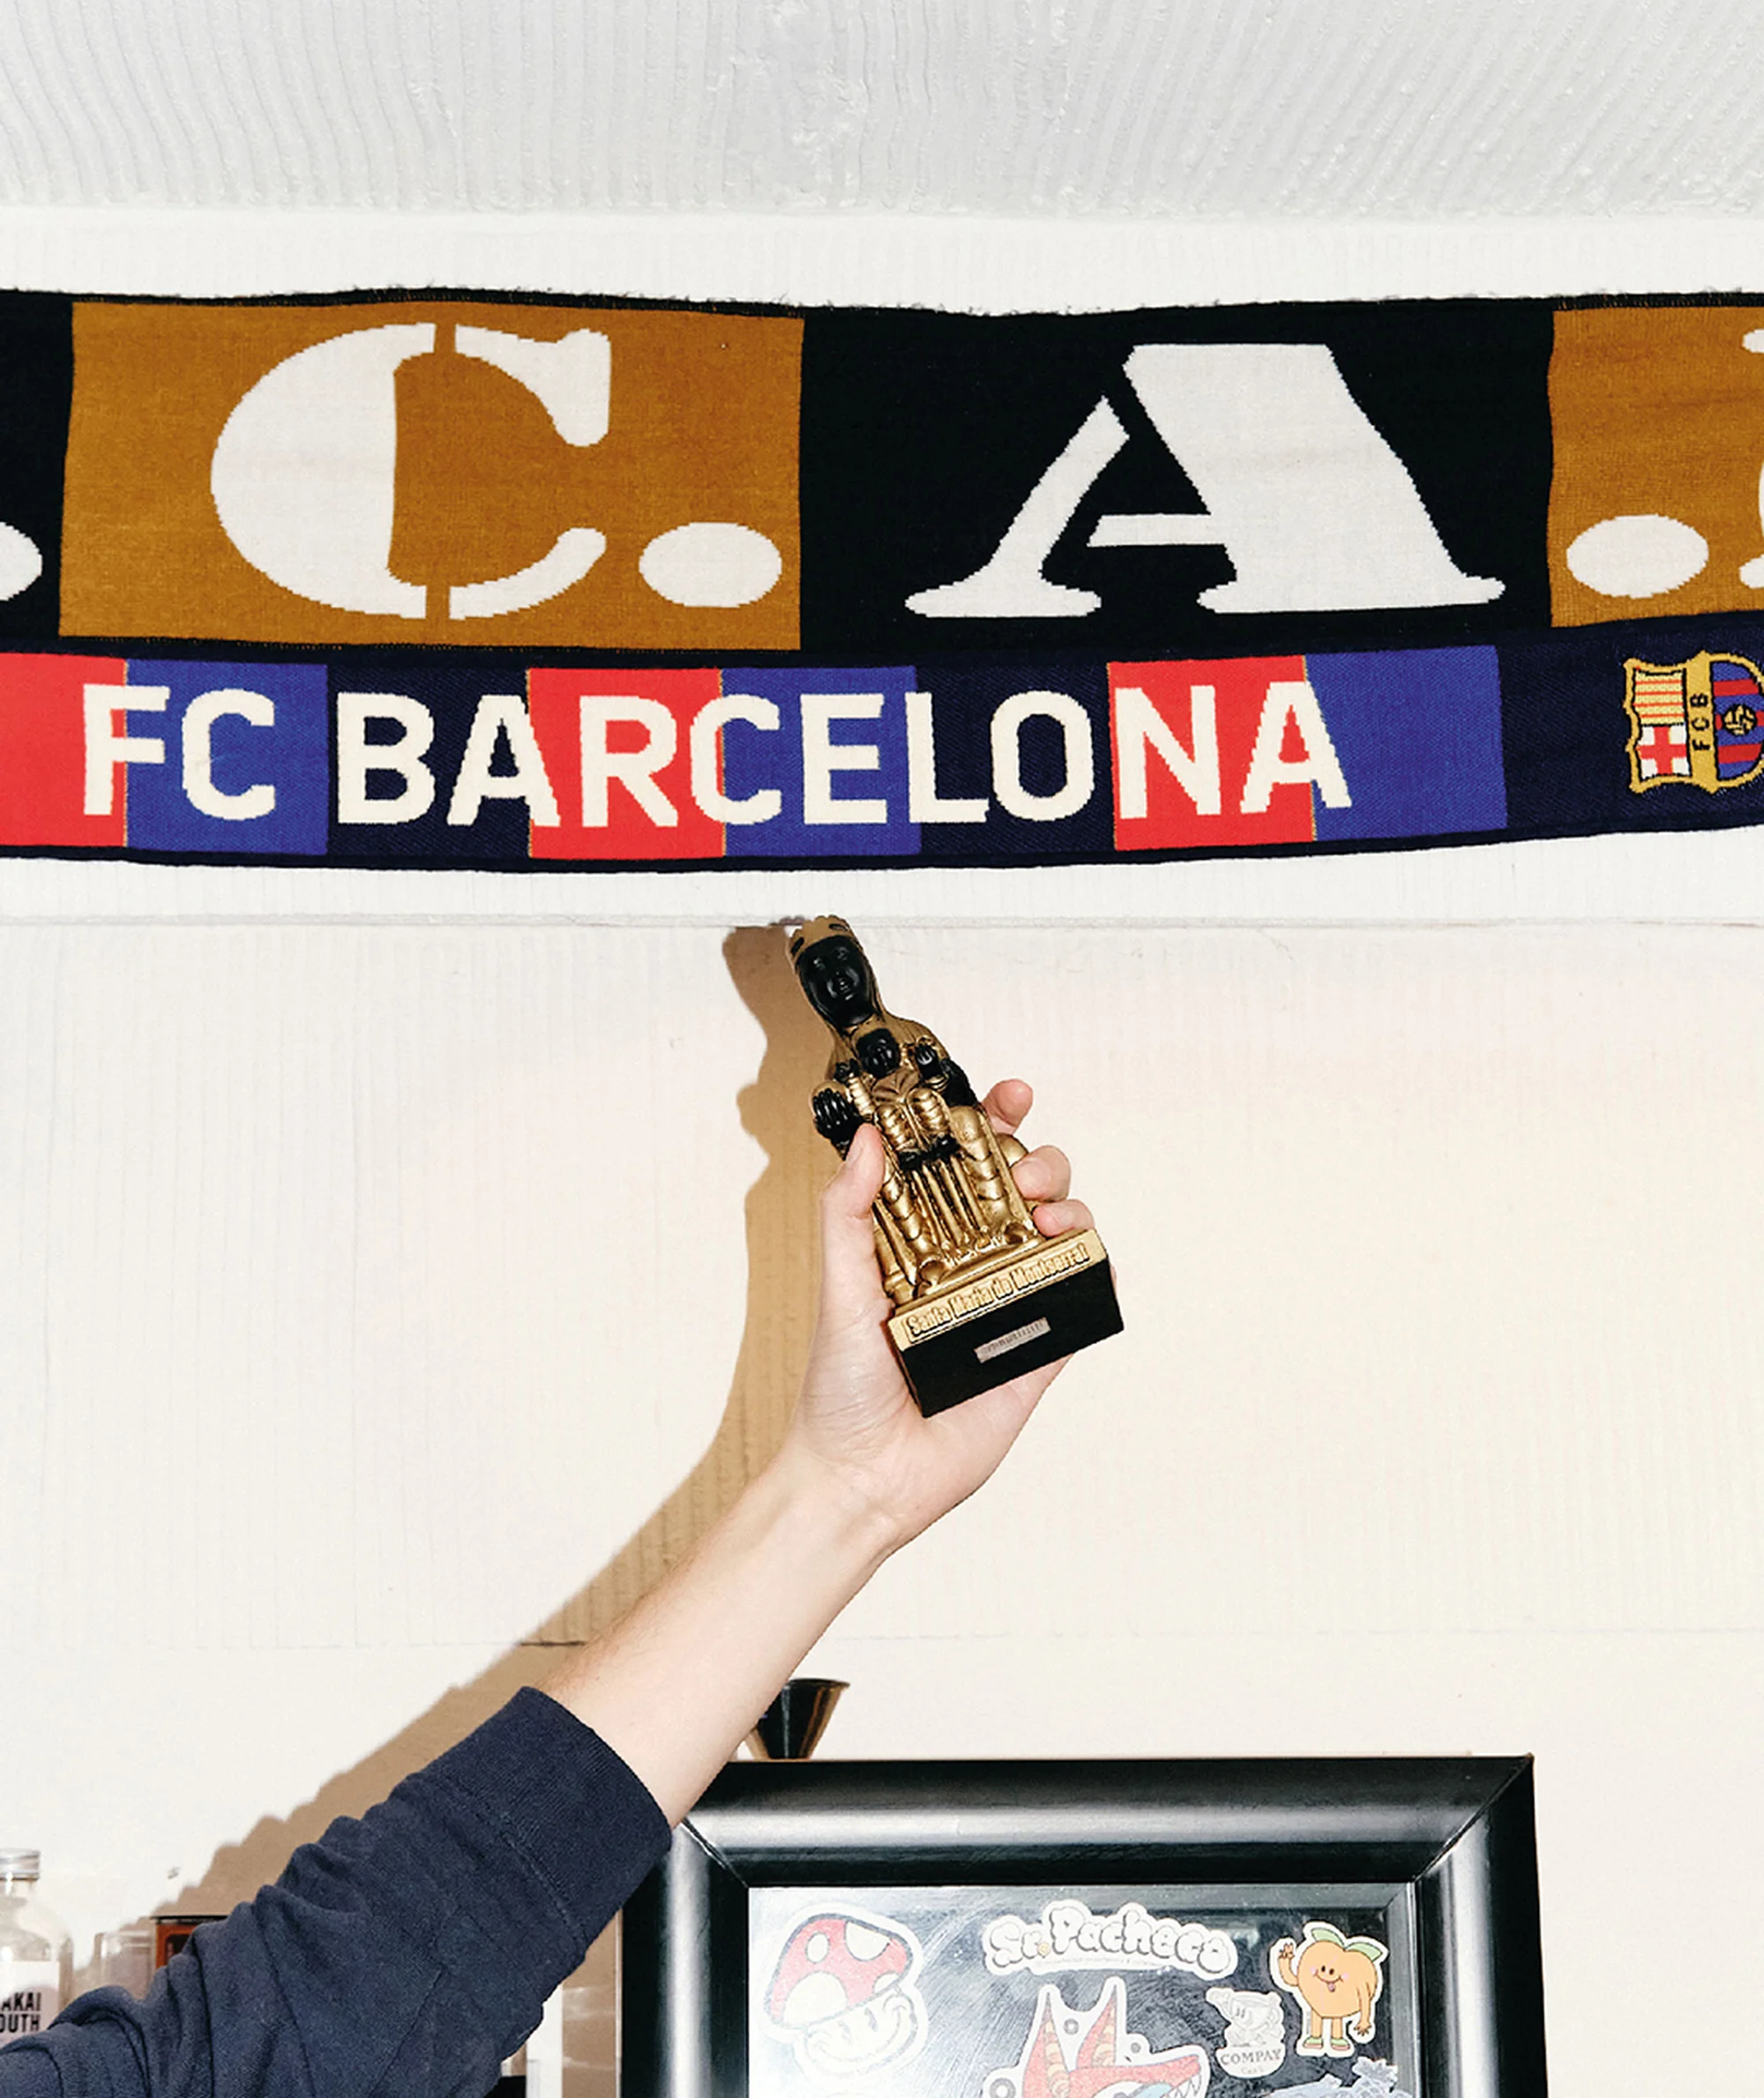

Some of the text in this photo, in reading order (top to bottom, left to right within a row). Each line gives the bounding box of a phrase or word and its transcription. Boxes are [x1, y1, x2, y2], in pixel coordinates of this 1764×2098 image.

[83, 681, 1353, 827] FC BARCELONA
[1689, 692, 1711, 751] FCB
[907, 1306, 953, 1335] Santa
[992, 1277, 1013, 1299] de
[1011, 1243, 1090, 1289] Montserrat
[1050, 1907, 1231, 1973] Pacheco
[1220, 2048, 1282, 2065] COMPAY
